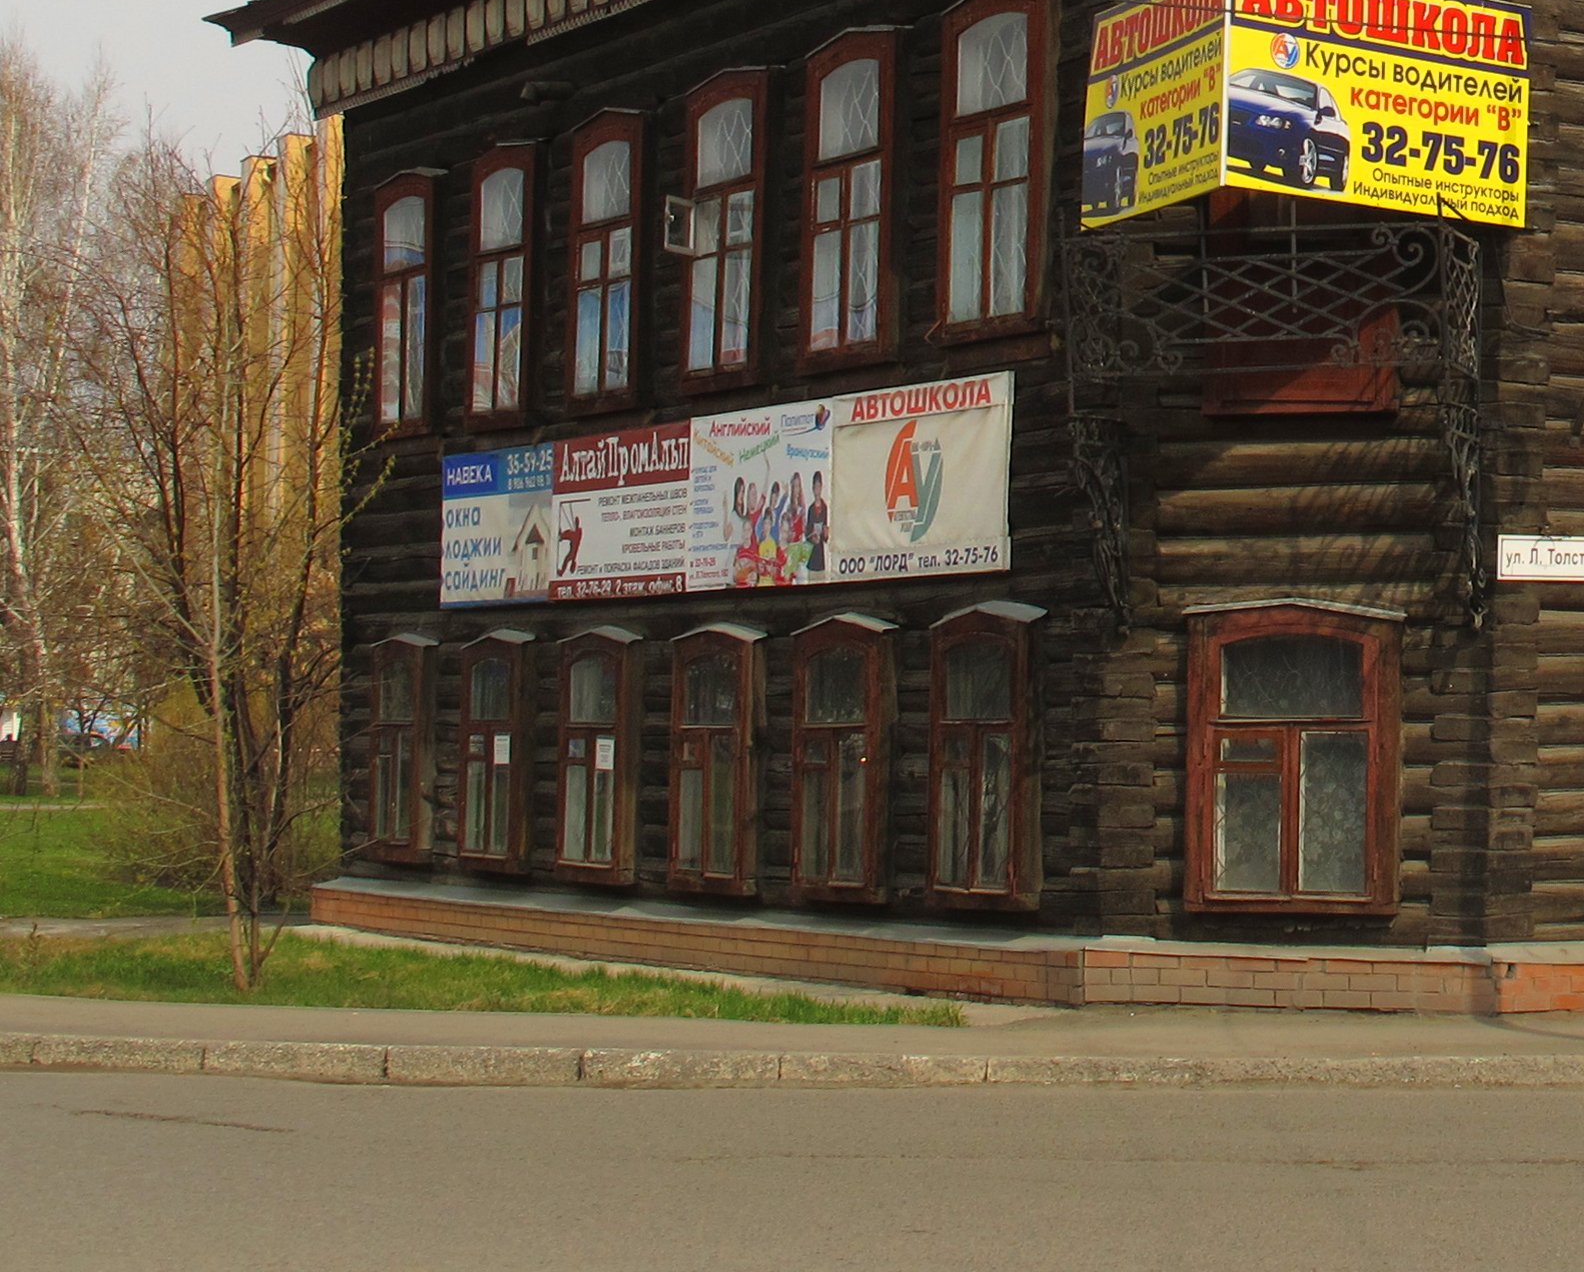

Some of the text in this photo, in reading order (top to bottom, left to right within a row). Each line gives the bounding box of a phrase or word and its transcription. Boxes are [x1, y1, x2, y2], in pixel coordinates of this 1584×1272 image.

[1120, 68, 1158, 100] Курсы
[1161, 33, 1221, 83] водителей
[1305, 42, 1522, 103] Курсы водителей
[1140, 78, 1200, 120] категории
[1350, 86, 1480, 126] категории
[1143, 102, 1219, 168] 32-75-76
[1361, 121, 1520, 184] 32-75-76
[1372, 168, 1519, 203] Опытные инструкторы
[1470, 201, 1519, 219] подход
[851, 379, 992, 422] АВТОШКОЛА
[709, 416, 771, 438] Английский
[447, 465, 493, 486] НАВЕКА
[507, 449, 553, 475] 35-59-25
[838, 557, 866, 575] ООО
[918, 555, 941, 569] тел.
[944, 545, 998, 567] 32-75-76
[1506, 552, 1525, 568] ул.
[1529, 547, 1543, 566] Л.
[615, 580, 622, 594] 2
[675, 575, 683, 592] 8
